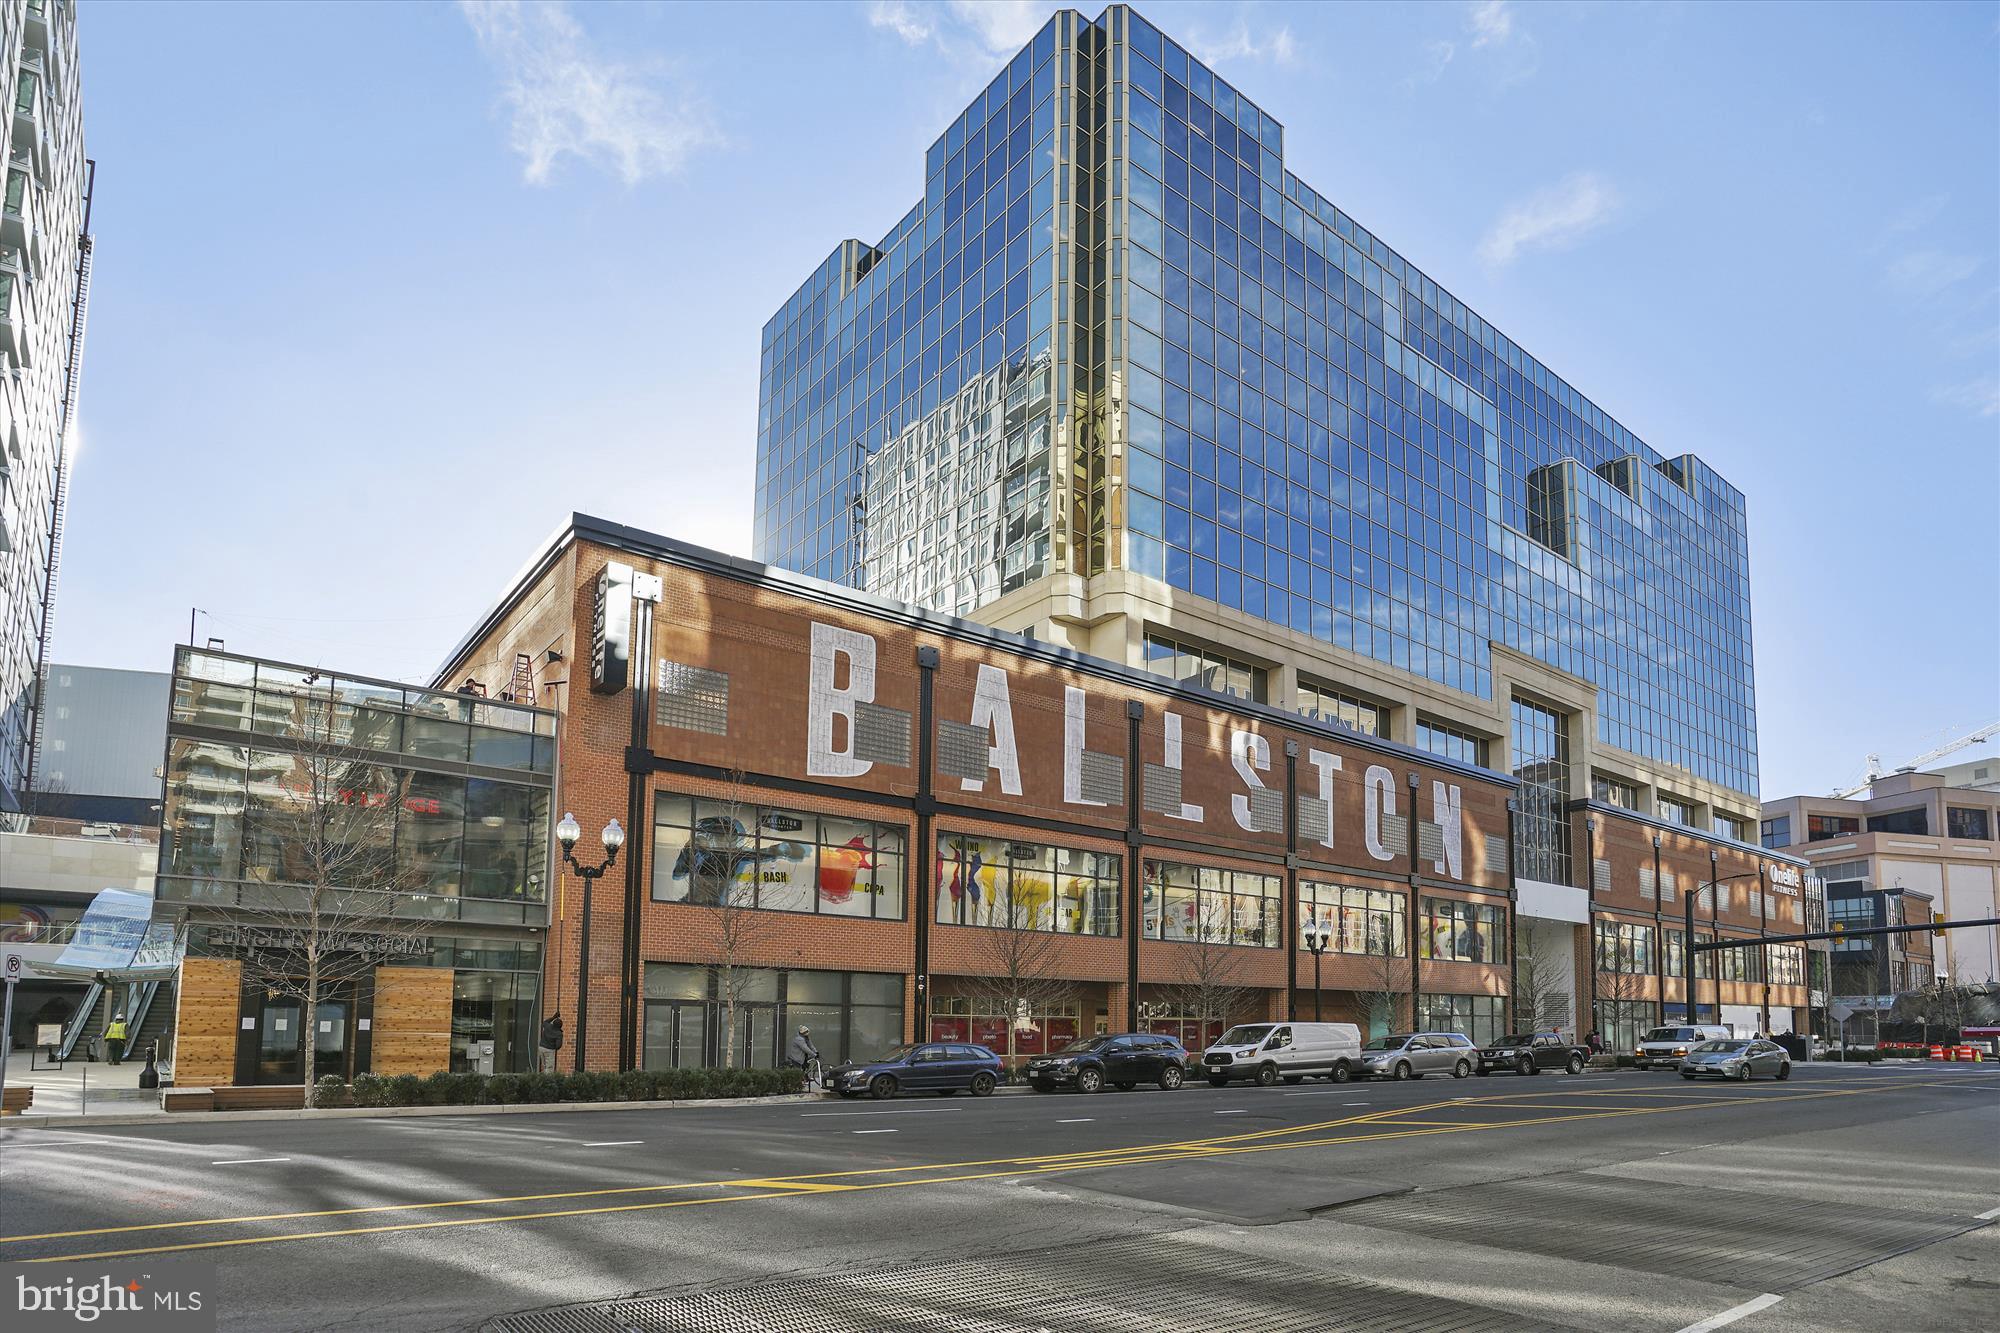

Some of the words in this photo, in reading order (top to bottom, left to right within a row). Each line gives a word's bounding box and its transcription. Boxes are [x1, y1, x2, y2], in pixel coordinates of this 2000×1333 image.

[807, 620, 1462, 881] BALLSTON
[955, 839, 979, 852] WINO
[763, 871, 787, 883] BASH
[1771, 864, 1799, 887] Onelife
[1773, 885, 1798, 896] FITNESS
[362, 937, 435, 955] SOCIAL
